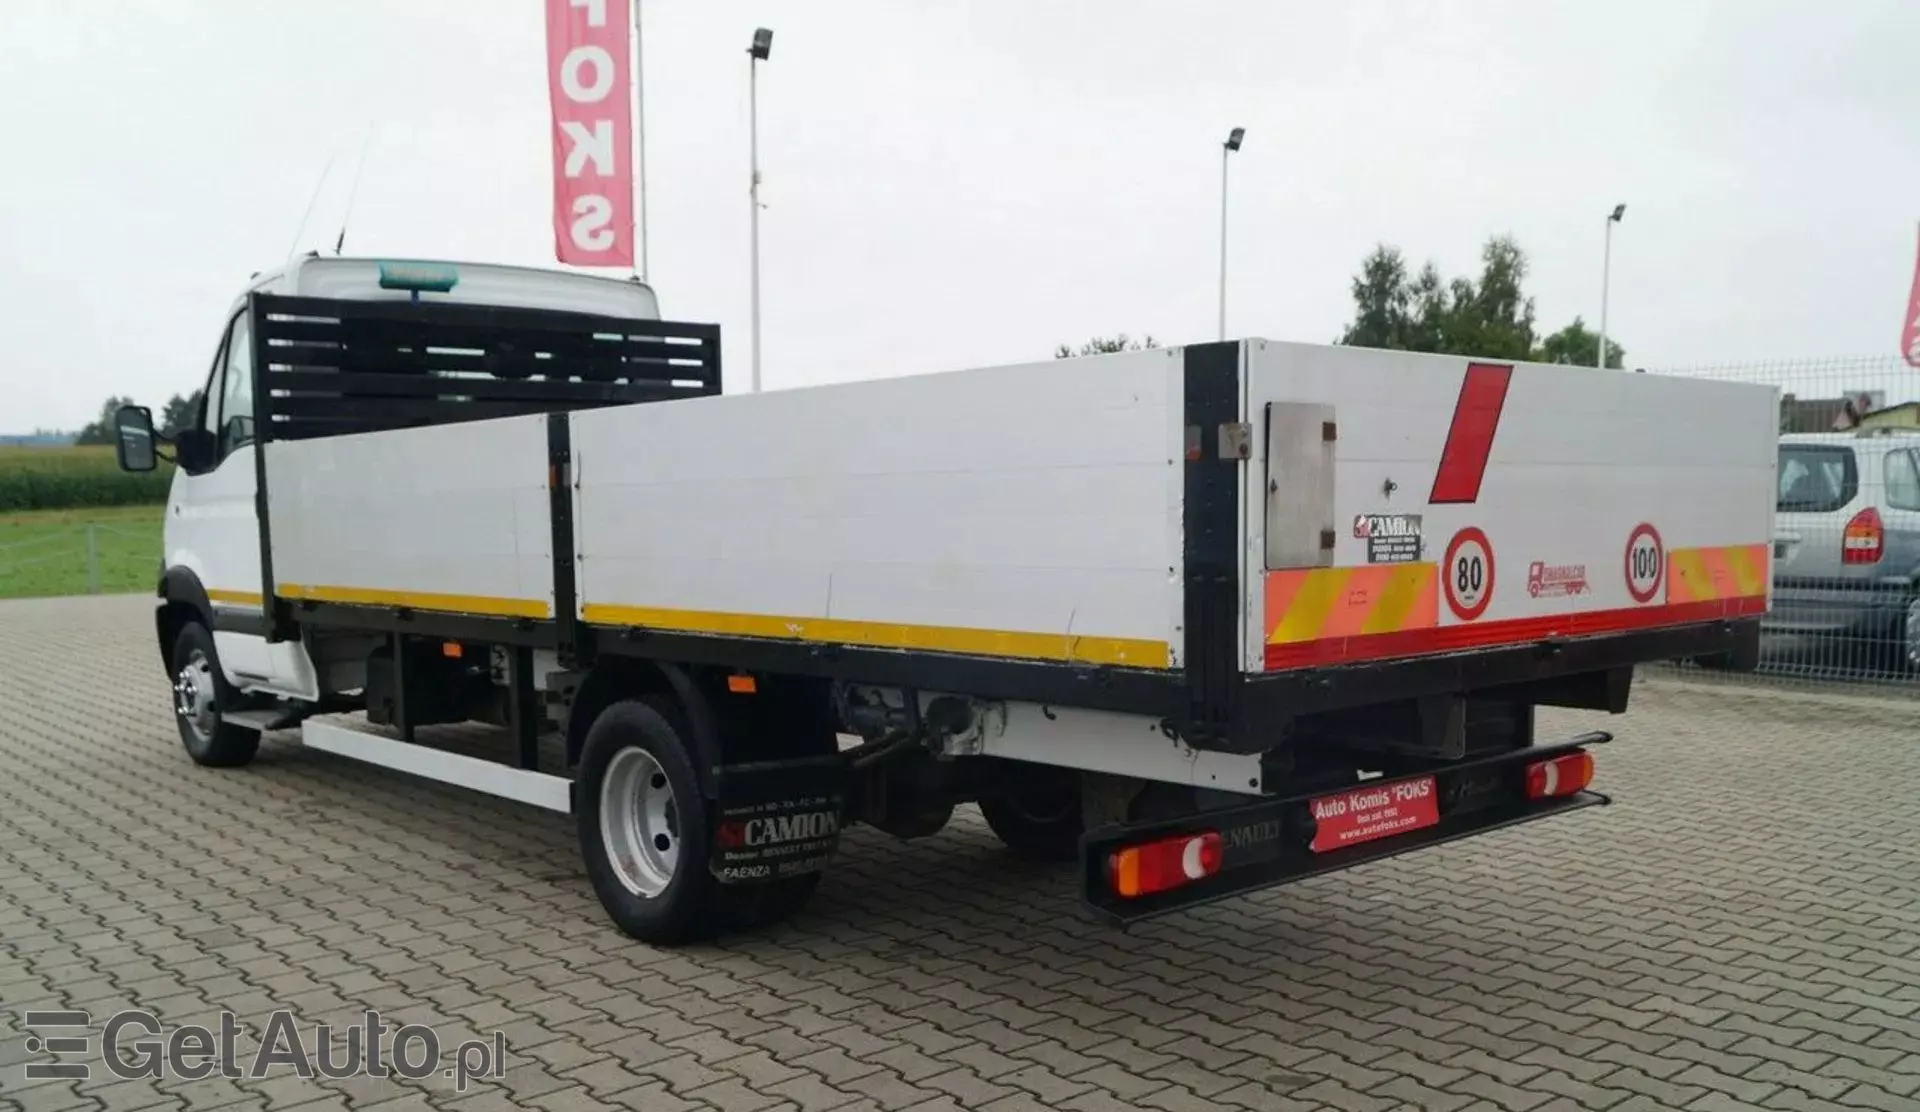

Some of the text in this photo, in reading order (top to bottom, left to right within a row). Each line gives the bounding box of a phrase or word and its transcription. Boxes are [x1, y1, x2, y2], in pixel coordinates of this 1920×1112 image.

[1458, 556, 1482, 592] 80
[1632, 547, 1657, 579] 100
[1315, 800, 1346, 820] Auto
[1349, 790, 1390, 811] Komis
[1221, 820, 1279, 849] ENAULT
